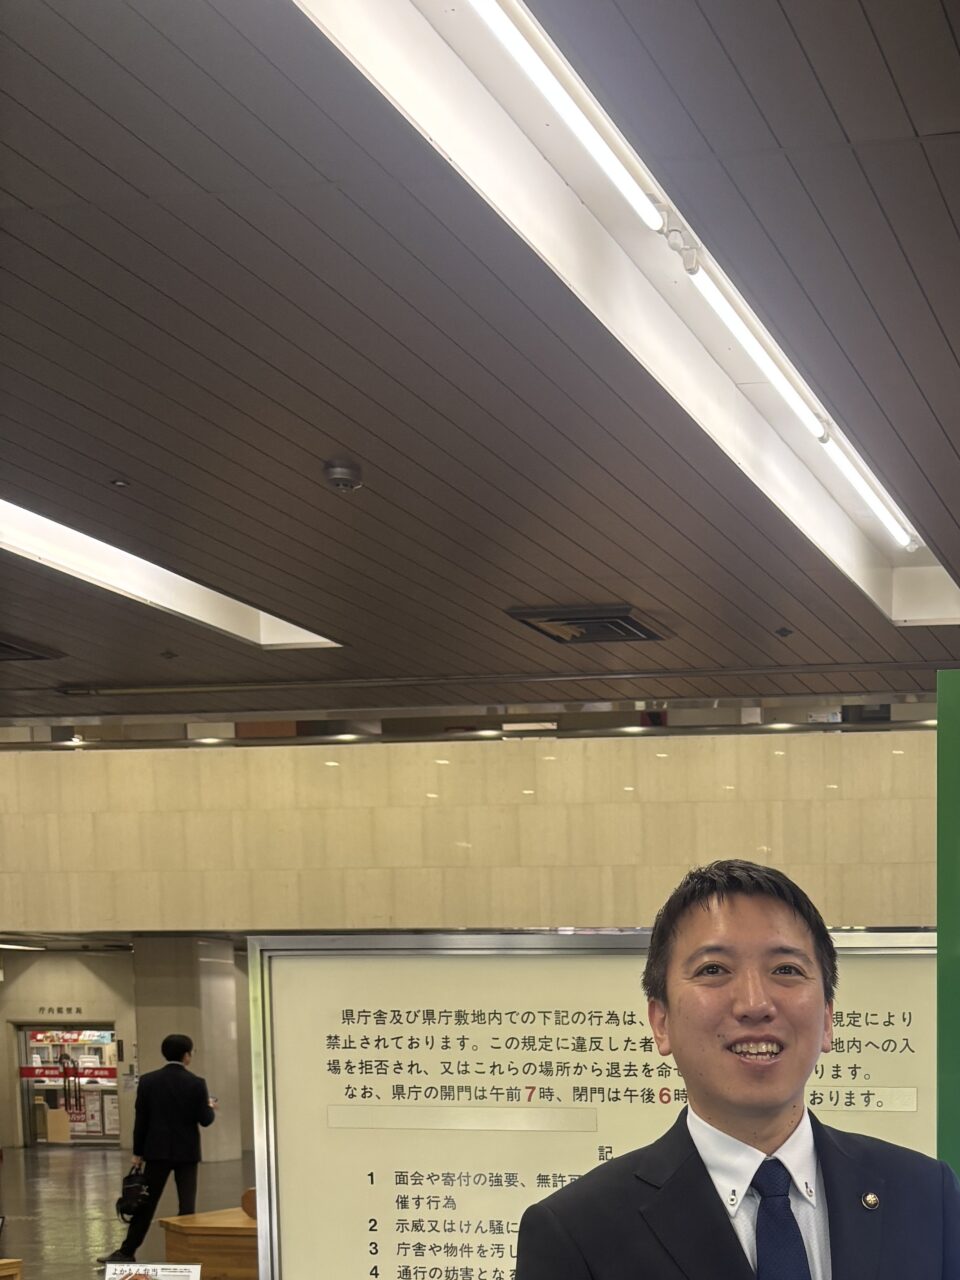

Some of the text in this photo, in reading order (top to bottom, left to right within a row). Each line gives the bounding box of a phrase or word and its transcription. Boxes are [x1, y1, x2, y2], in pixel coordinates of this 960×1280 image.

[341, 1009, 645, 1028] 県庁舎及び県庁敷地内での下記の行為は、
[326, 1034, 655, 1053] 禁止されております。この規定に違反した者
[814, 1063, 871, 1080] ります。
[344, 1083, 884, 1108] なお、県庁の開門は午前7時、閉門は午後6時 おります。
[598, 1146, 613, 1161] 記
[367, 1172, 375, 1185] 1
[395, 1194, 457, 1210] 催す行為
[368, 1218, 378, 1232] 2
[369, 1242, 379, 1255] 3
[369, 1265, 379, 1278] 4
